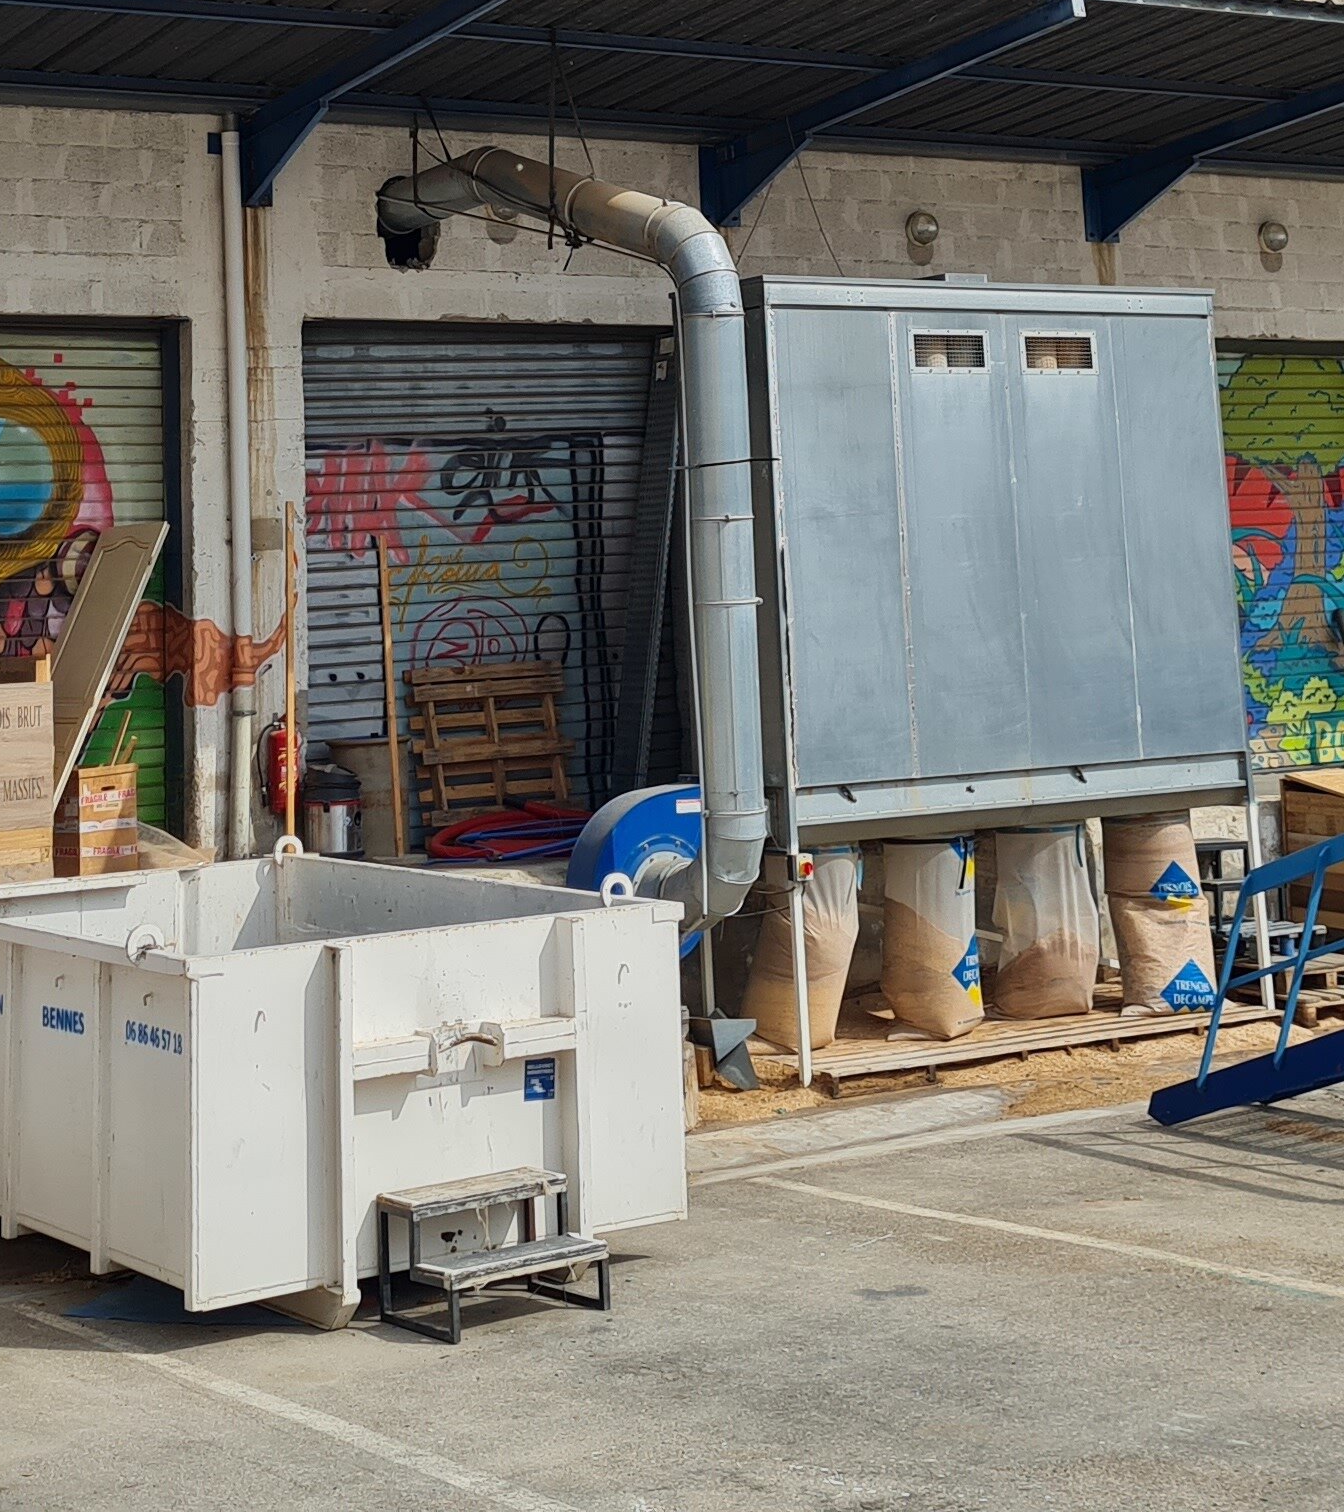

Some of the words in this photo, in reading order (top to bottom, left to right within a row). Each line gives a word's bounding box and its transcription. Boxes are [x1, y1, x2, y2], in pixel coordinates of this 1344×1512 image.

[17, 705, 42, 728] BRUT
[42, 1005, 85, 1034] BENNES
[125, 1020, 136, 1042] 06
[137, 1022, 148, 1045] 86
[149, 1026, 160, 1048] 46
[161, 1028, 171, 1052] 57
[172, 1031, 183, 1055] 18
